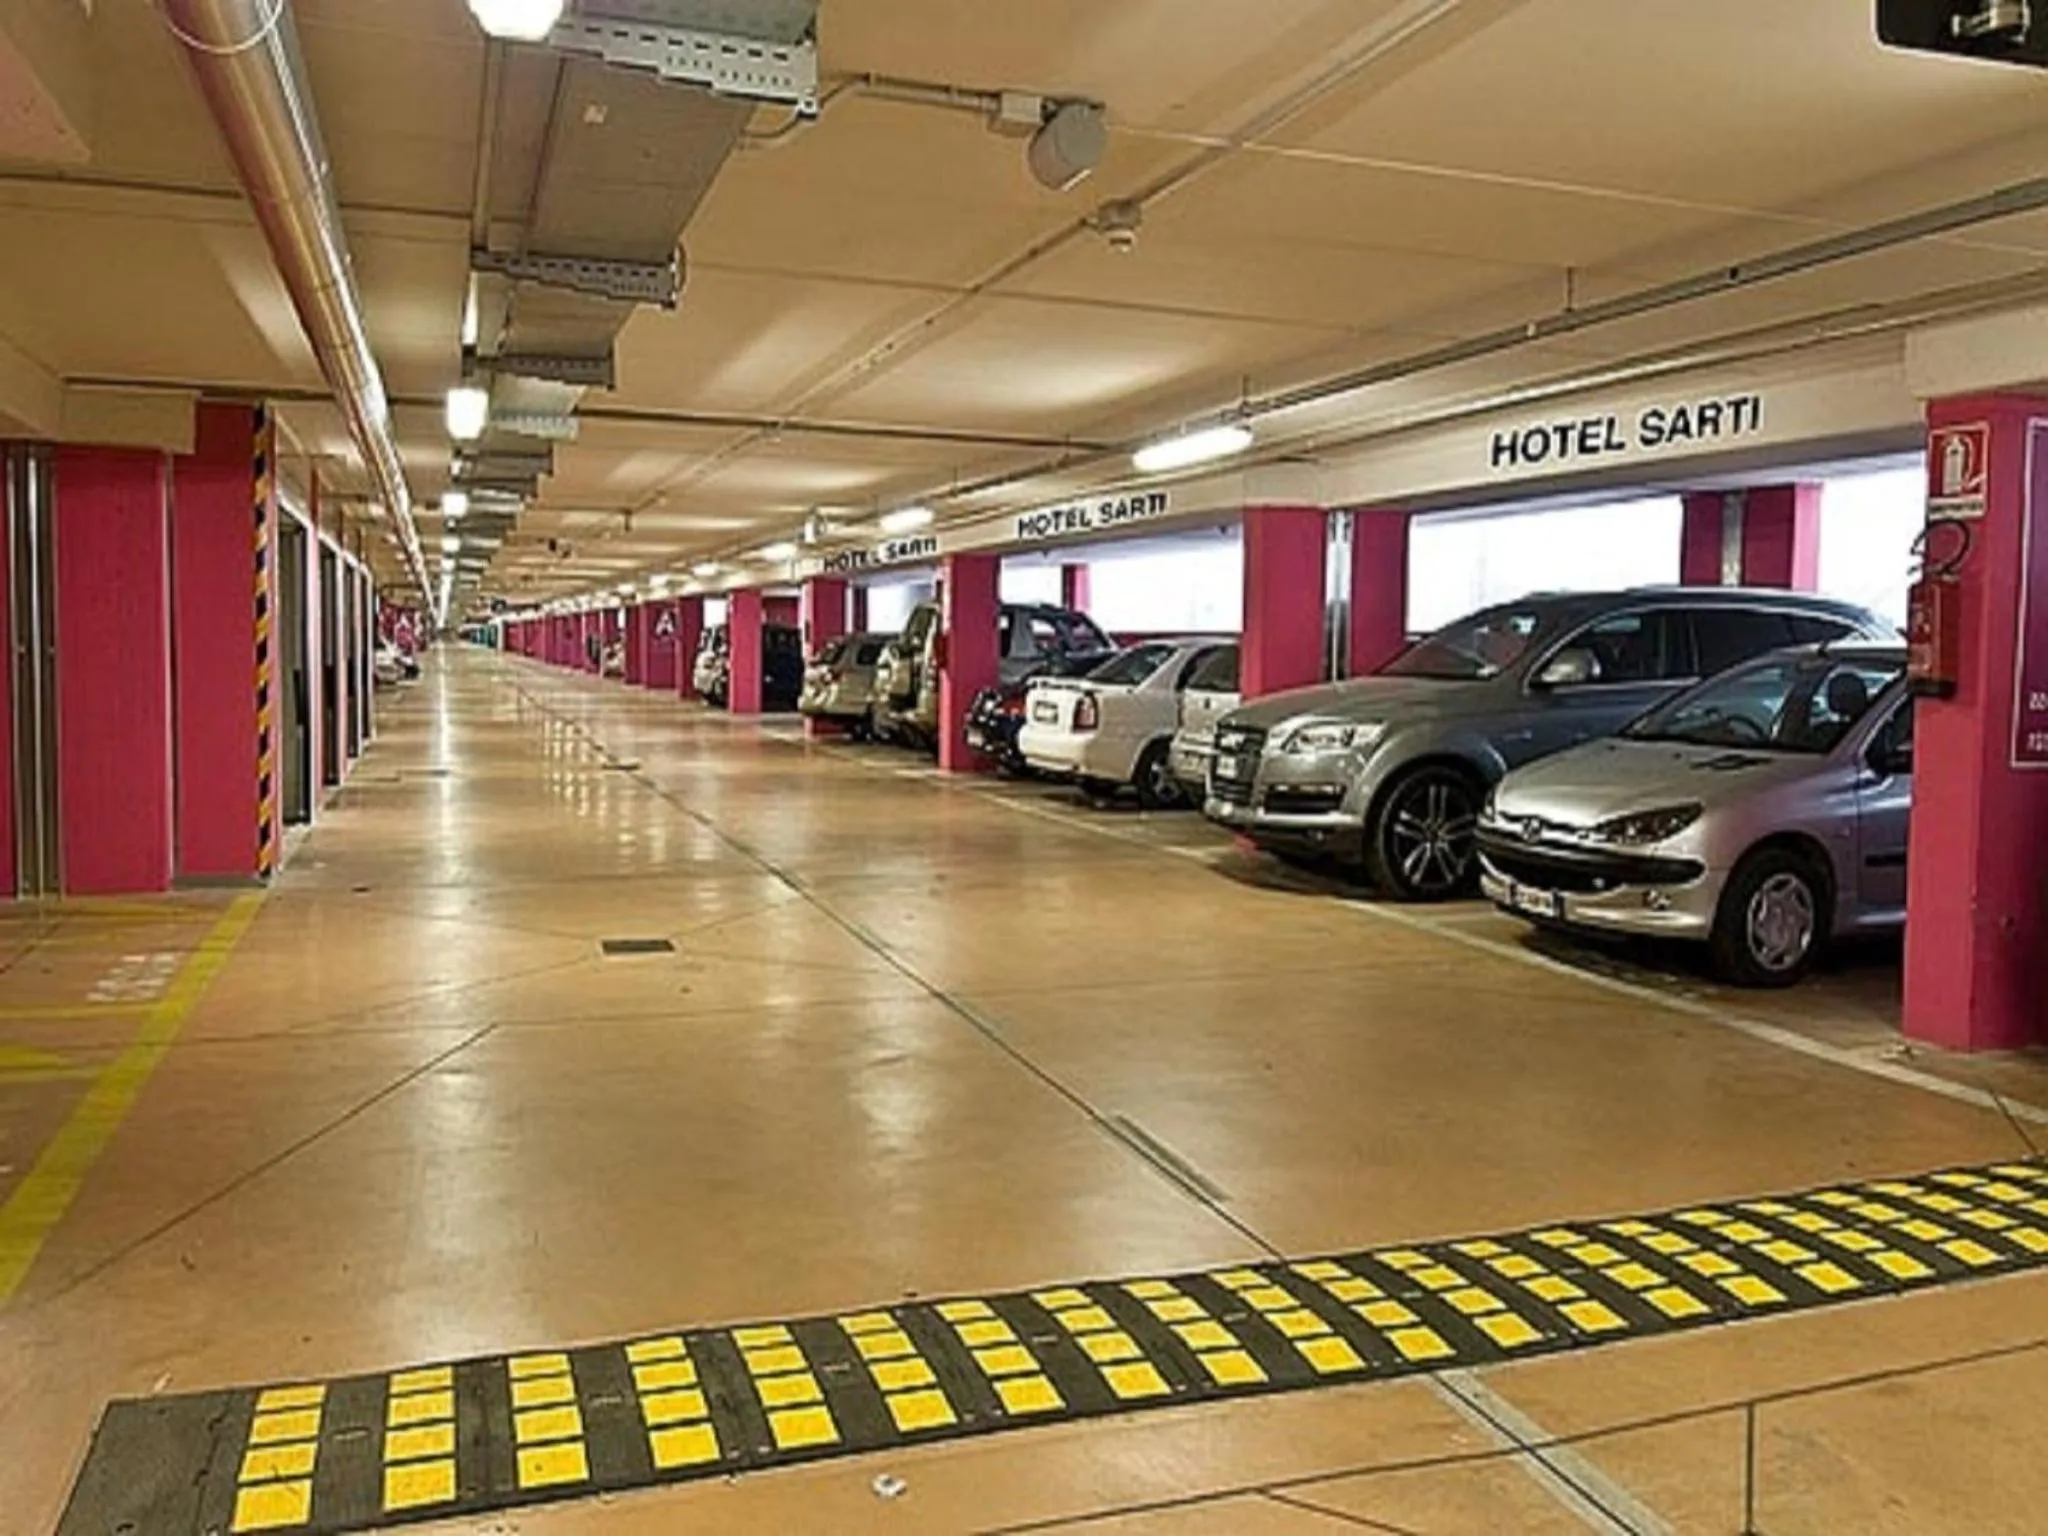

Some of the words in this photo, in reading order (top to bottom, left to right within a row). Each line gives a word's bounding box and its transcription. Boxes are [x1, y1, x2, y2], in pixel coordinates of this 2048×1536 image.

[1491, 415, 1626, 467] HOTEL
[1639, 396, 1760, 447] SARTI
[1018, 507, 1092, 539] HOTEL
[1098, 493, 1167, 524] SARTI
